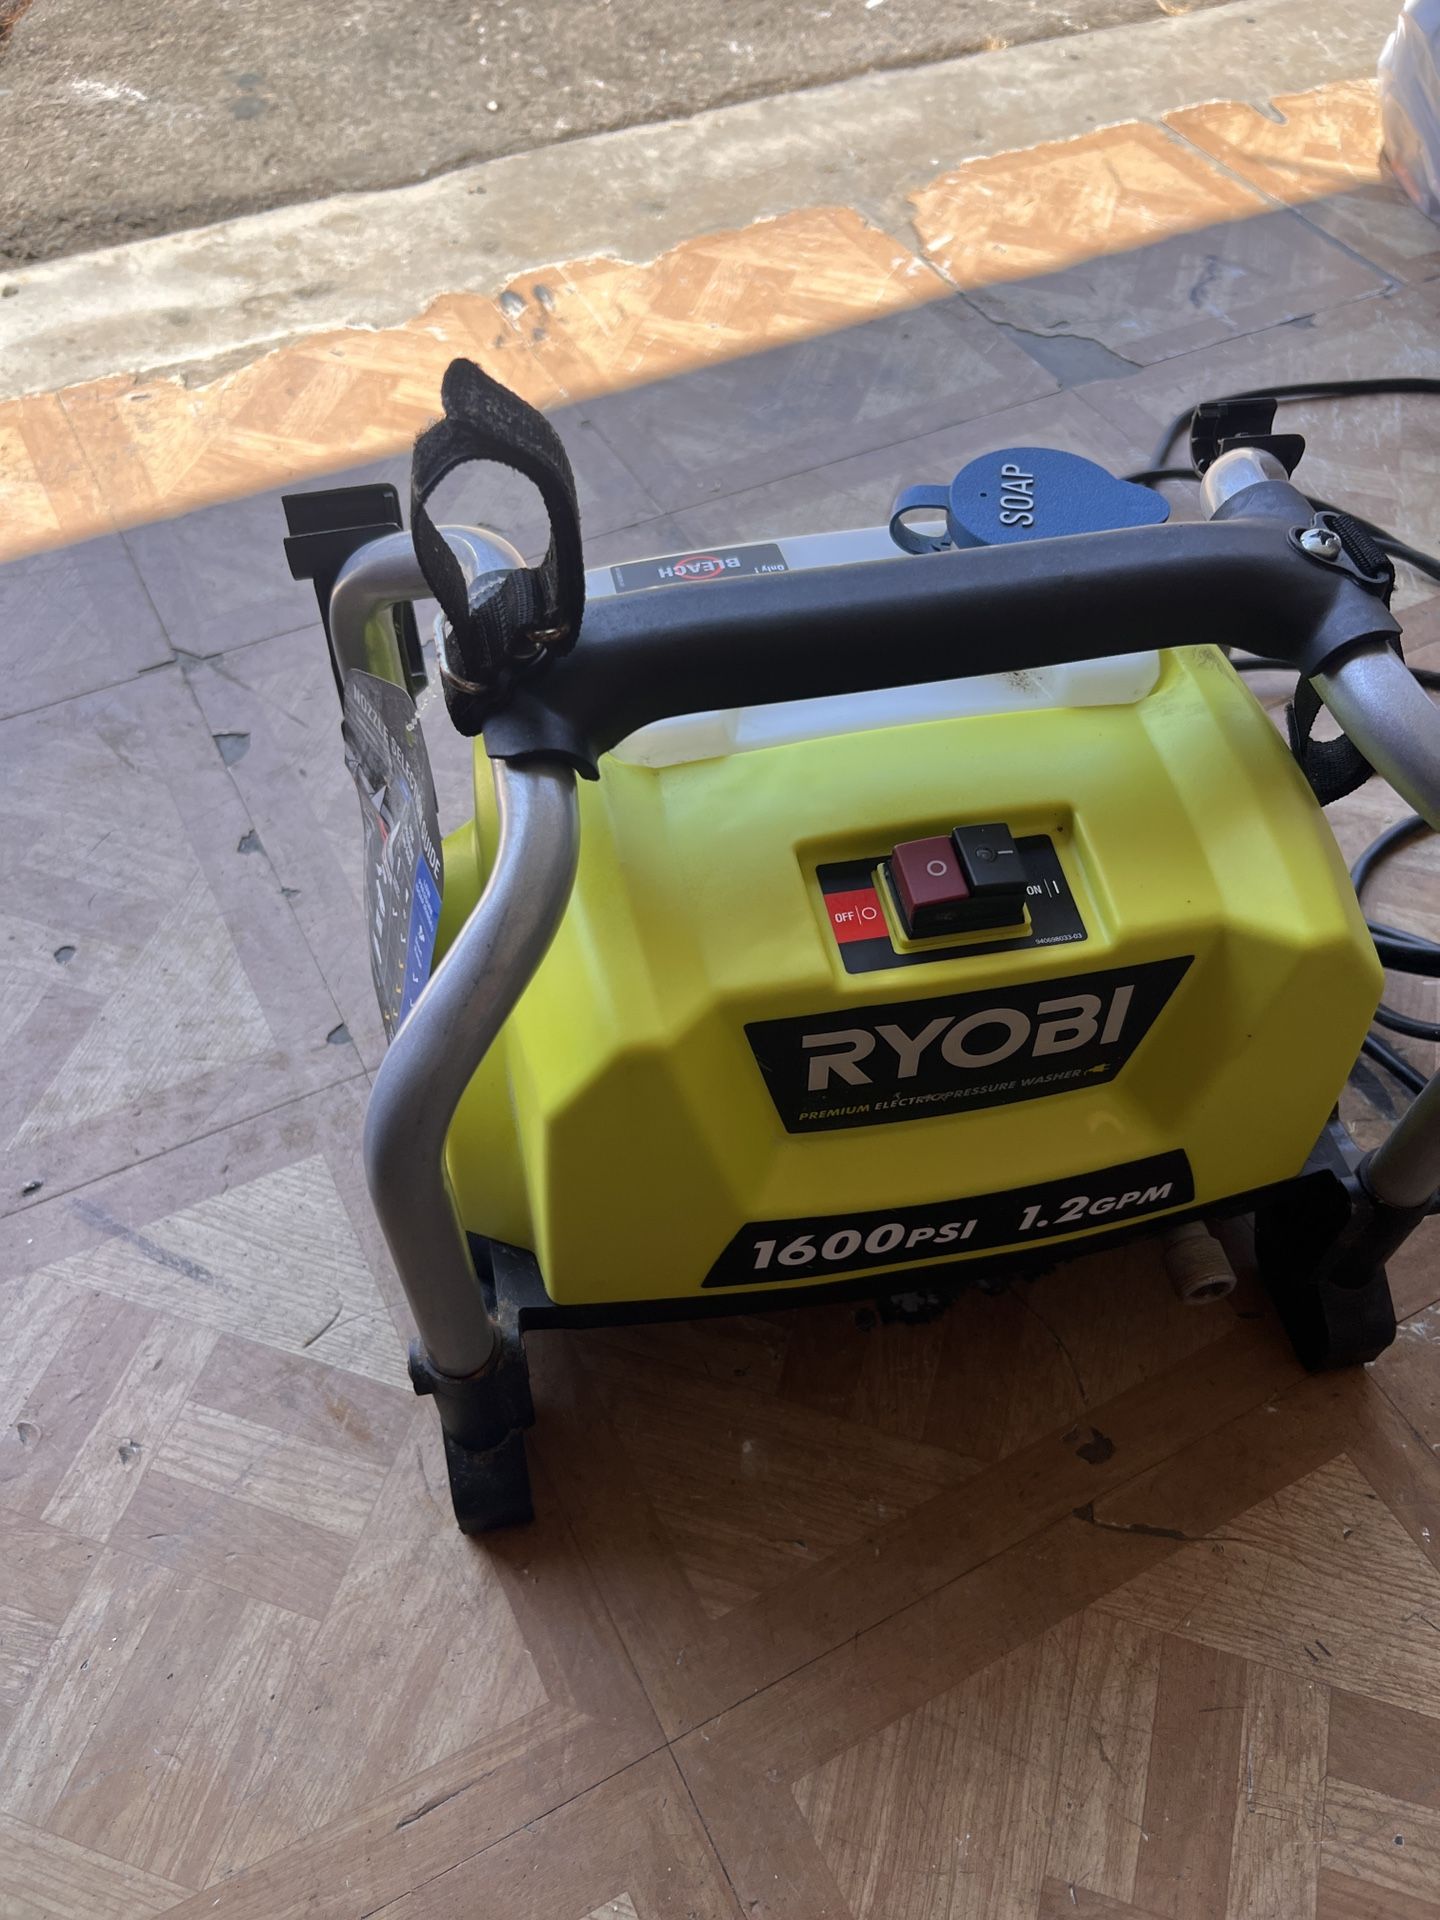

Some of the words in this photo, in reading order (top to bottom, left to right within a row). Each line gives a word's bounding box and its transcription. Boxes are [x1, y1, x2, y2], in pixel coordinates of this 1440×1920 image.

[1000, 464, 1034, 526] SOAP
[657, 557, 741, 578] BLEACH
[762, 564, 785, 574] Only
[353, 684, 390, 741] NOZZLE
[420, 821, 441, 879] GUIDE
[1026, 884, 1042, 896] ON
[834, 911, 855, 923] OFF
[802, 985, 1135, 1091] RYOBI
[799, 1104, 870, 1121] PREMIUM
[874, 1093, 942, 1111] ELECTRIC
[943, 1081, 1016, 1101] PRESSURE
[1021, 1069, 1082, 1088] WASHER
[753, 1219, 978, 1269] 1600PSI
[1018, 1182, 1173, 1231] 1.2GPM
